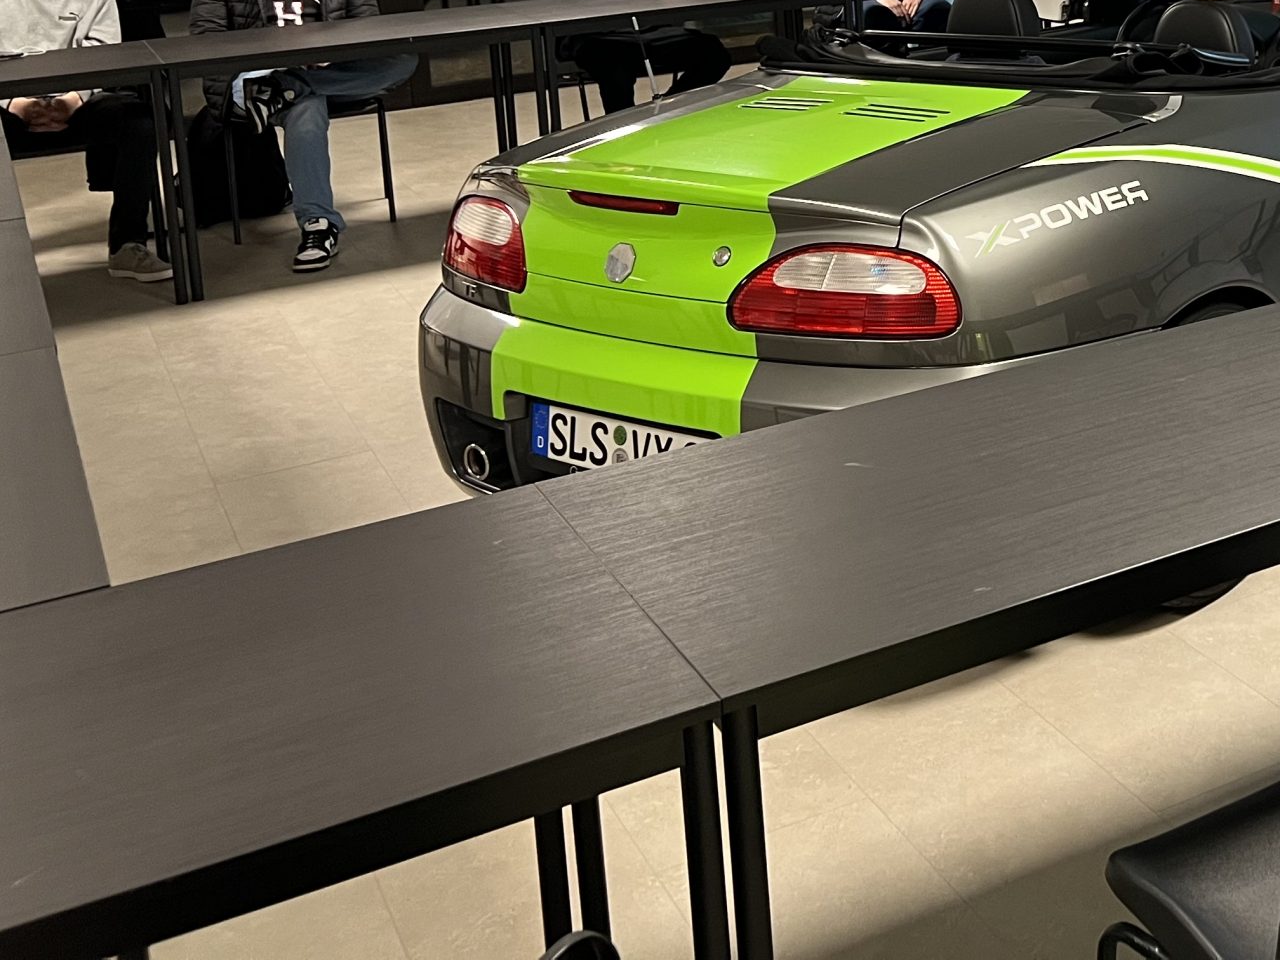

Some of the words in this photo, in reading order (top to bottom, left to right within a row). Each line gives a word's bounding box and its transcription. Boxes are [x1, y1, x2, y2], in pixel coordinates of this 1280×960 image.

[965, 180, 1149, 259] XPOWER
[536, 436, 545, 448] D
[549, 413, 609, 466] SLS
